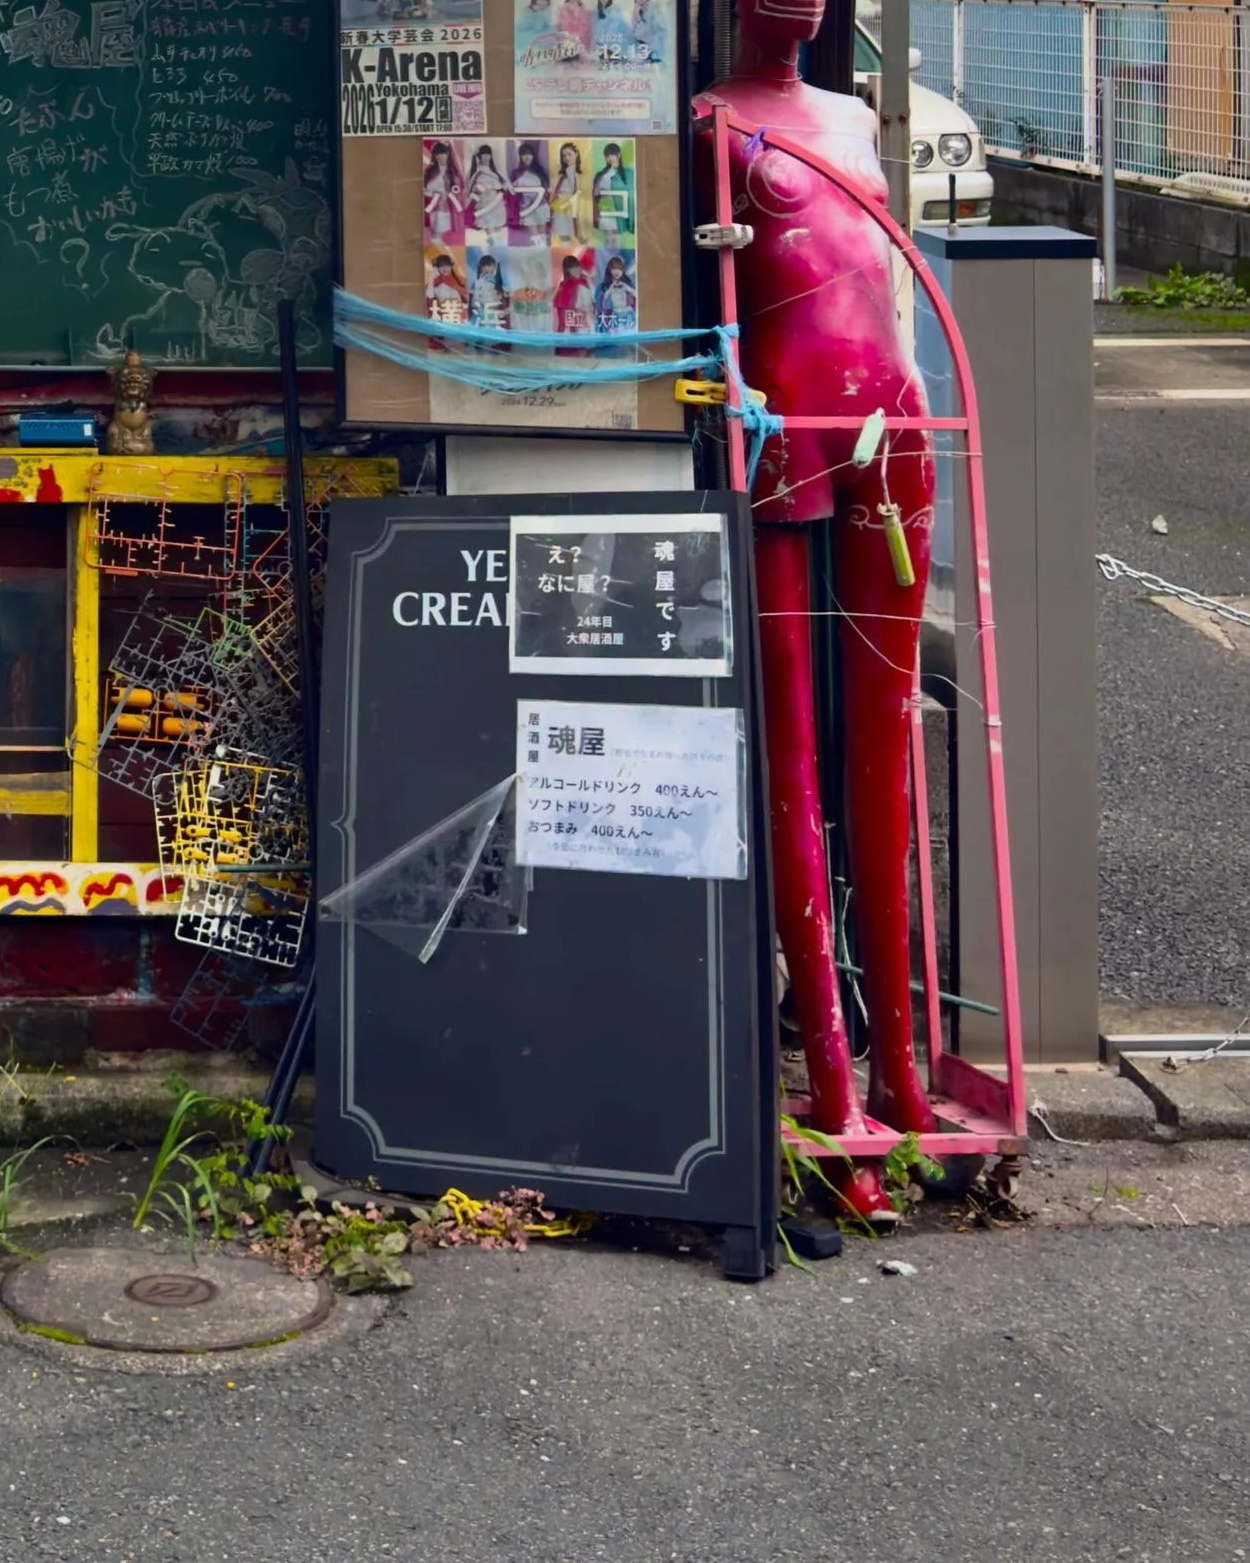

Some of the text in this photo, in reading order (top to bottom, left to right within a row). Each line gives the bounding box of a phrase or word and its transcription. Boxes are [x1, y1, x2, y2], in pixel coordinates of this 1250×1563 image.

[341, 28, 482, 45] 新春大学芸会 2026
[341, 47, 483, 84] K-Arena
[599, 44, 650, 60] 12.13
[376, 83, 450, 98] Yokohama
[8, 92, 96, 136] たぶん
[342, 85, 375, 134] 2026
[375, 96, 435, 125] 1/12
[6, 131, 109, 177] 唐揚げが
[429, 299, 507, 328] 横浜
[392, 591, 511, 627] CREA
[654, 540, 676, 652] 魂屋です
[577, 615, 613, 629] 24年目
[566, 632, 625, 647] 大衆居酒屋
[528, 712, 541, 763] 居酒屋
[547, 724, 607, 757] 魂屋
[530, 776, 642, 796] アルコールドリンク
[527, 798, 617, 815] ソフトドリンク
[527, 820, 579, 836] おつまみ
